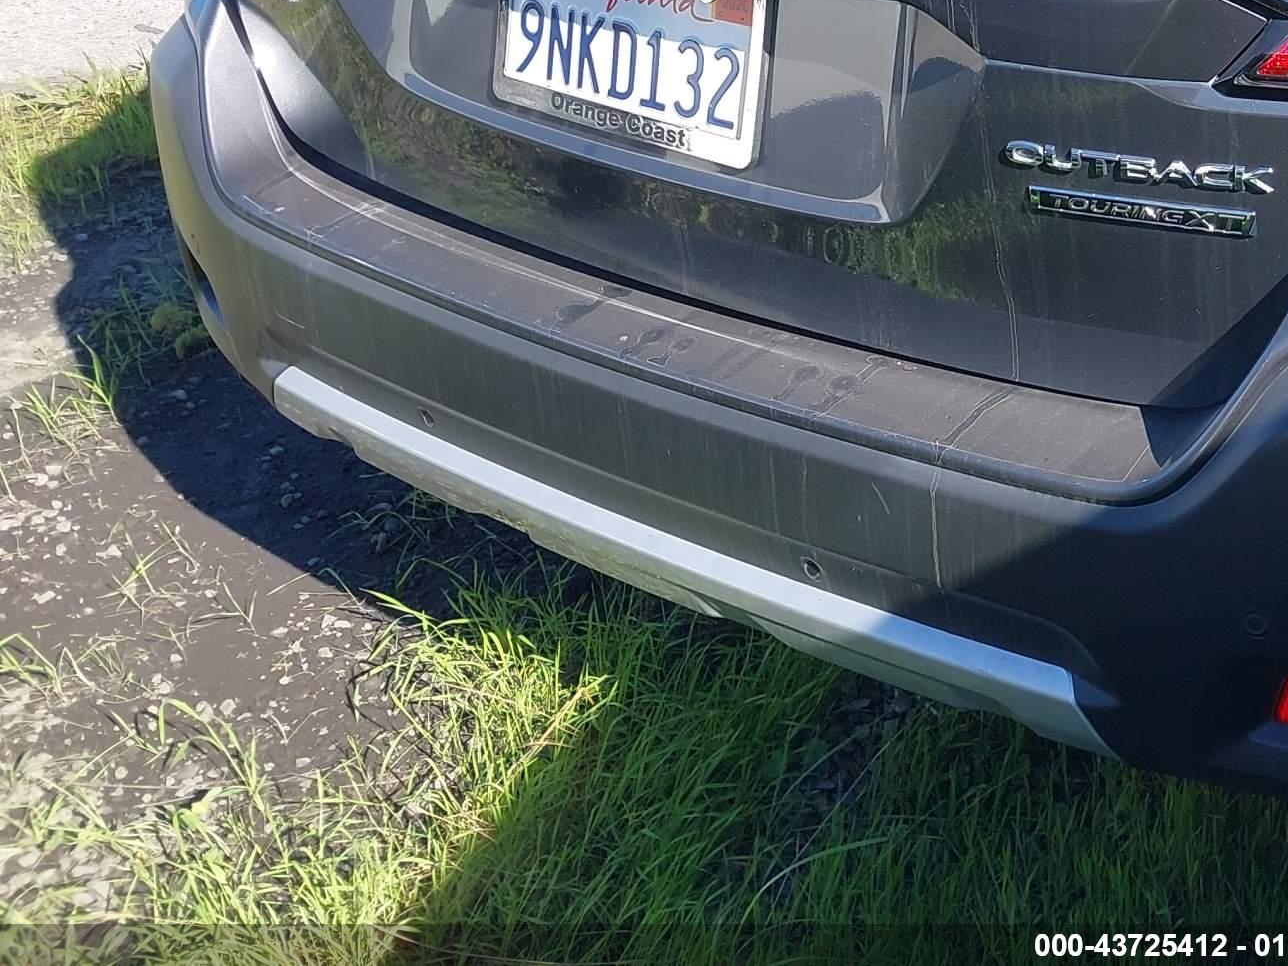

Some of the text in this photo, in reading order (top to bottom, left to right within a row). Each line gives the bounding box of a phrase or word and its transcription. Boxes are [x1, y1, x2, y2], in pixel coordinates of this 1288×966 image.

[516, 0, 741, 130] 9NKD132
[550, 93, 687, 147] Orange Coast
[1005, 139, 1275, 194] OUTBACK
